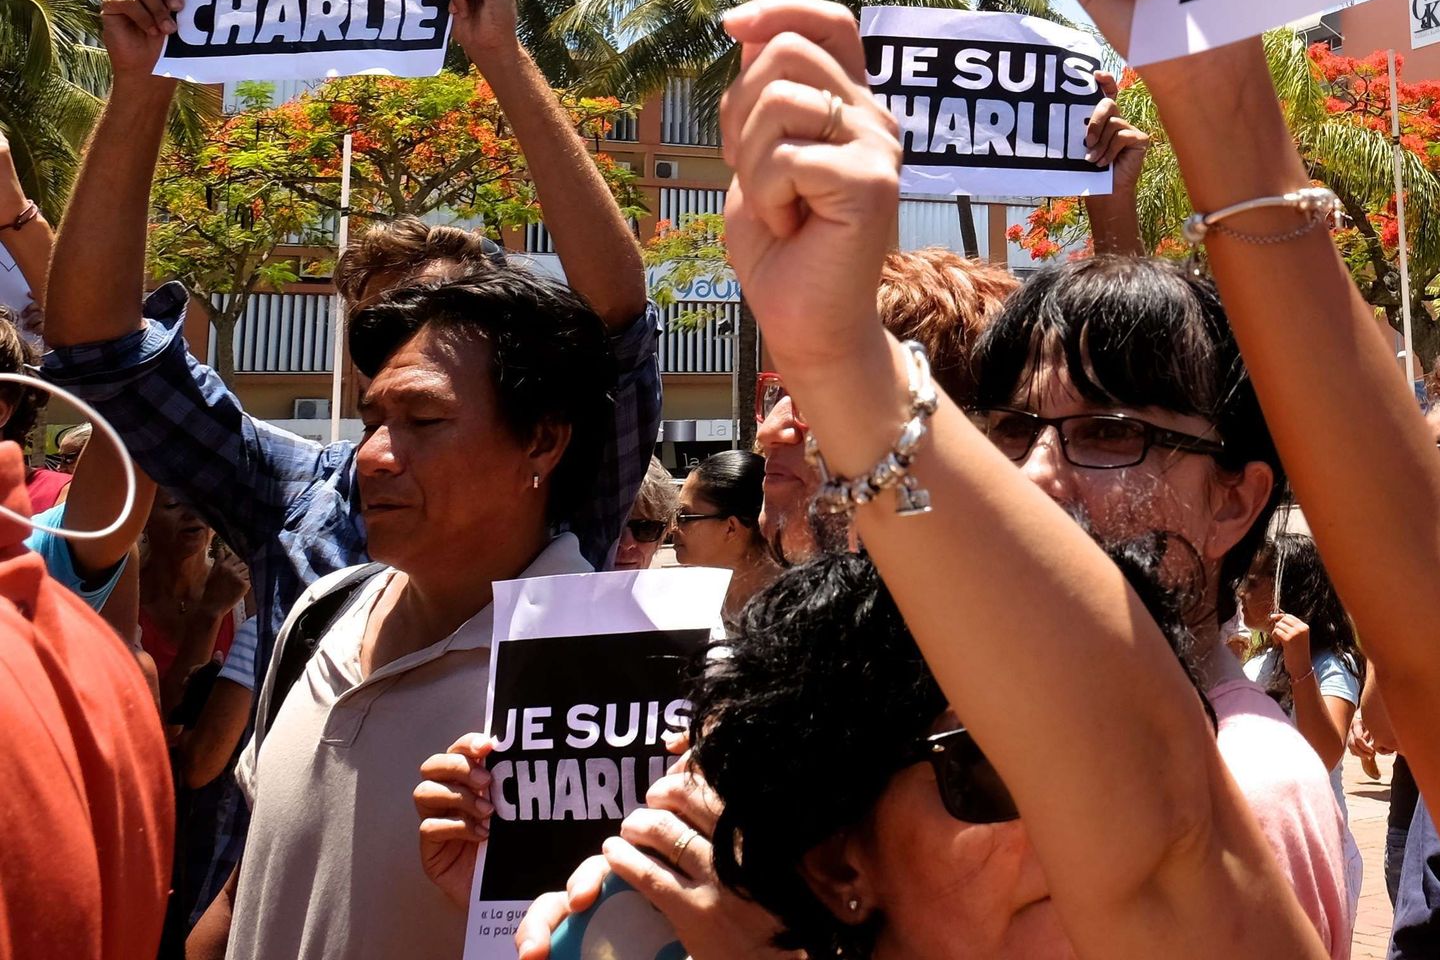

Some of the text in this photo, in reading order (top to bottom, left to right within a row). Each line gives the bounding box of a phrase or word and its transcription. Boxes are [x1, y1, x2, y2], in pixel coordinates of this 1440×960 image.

[866, 45, 1099, 96] JE SUIS
[494, 698, 693, 753] JE SUIS
[489, 755, 681, 821] CHARLI
[479, 924, 491, 936] la
[491, 908, 504, 920] La
[506, 910, 528, 922] gue
